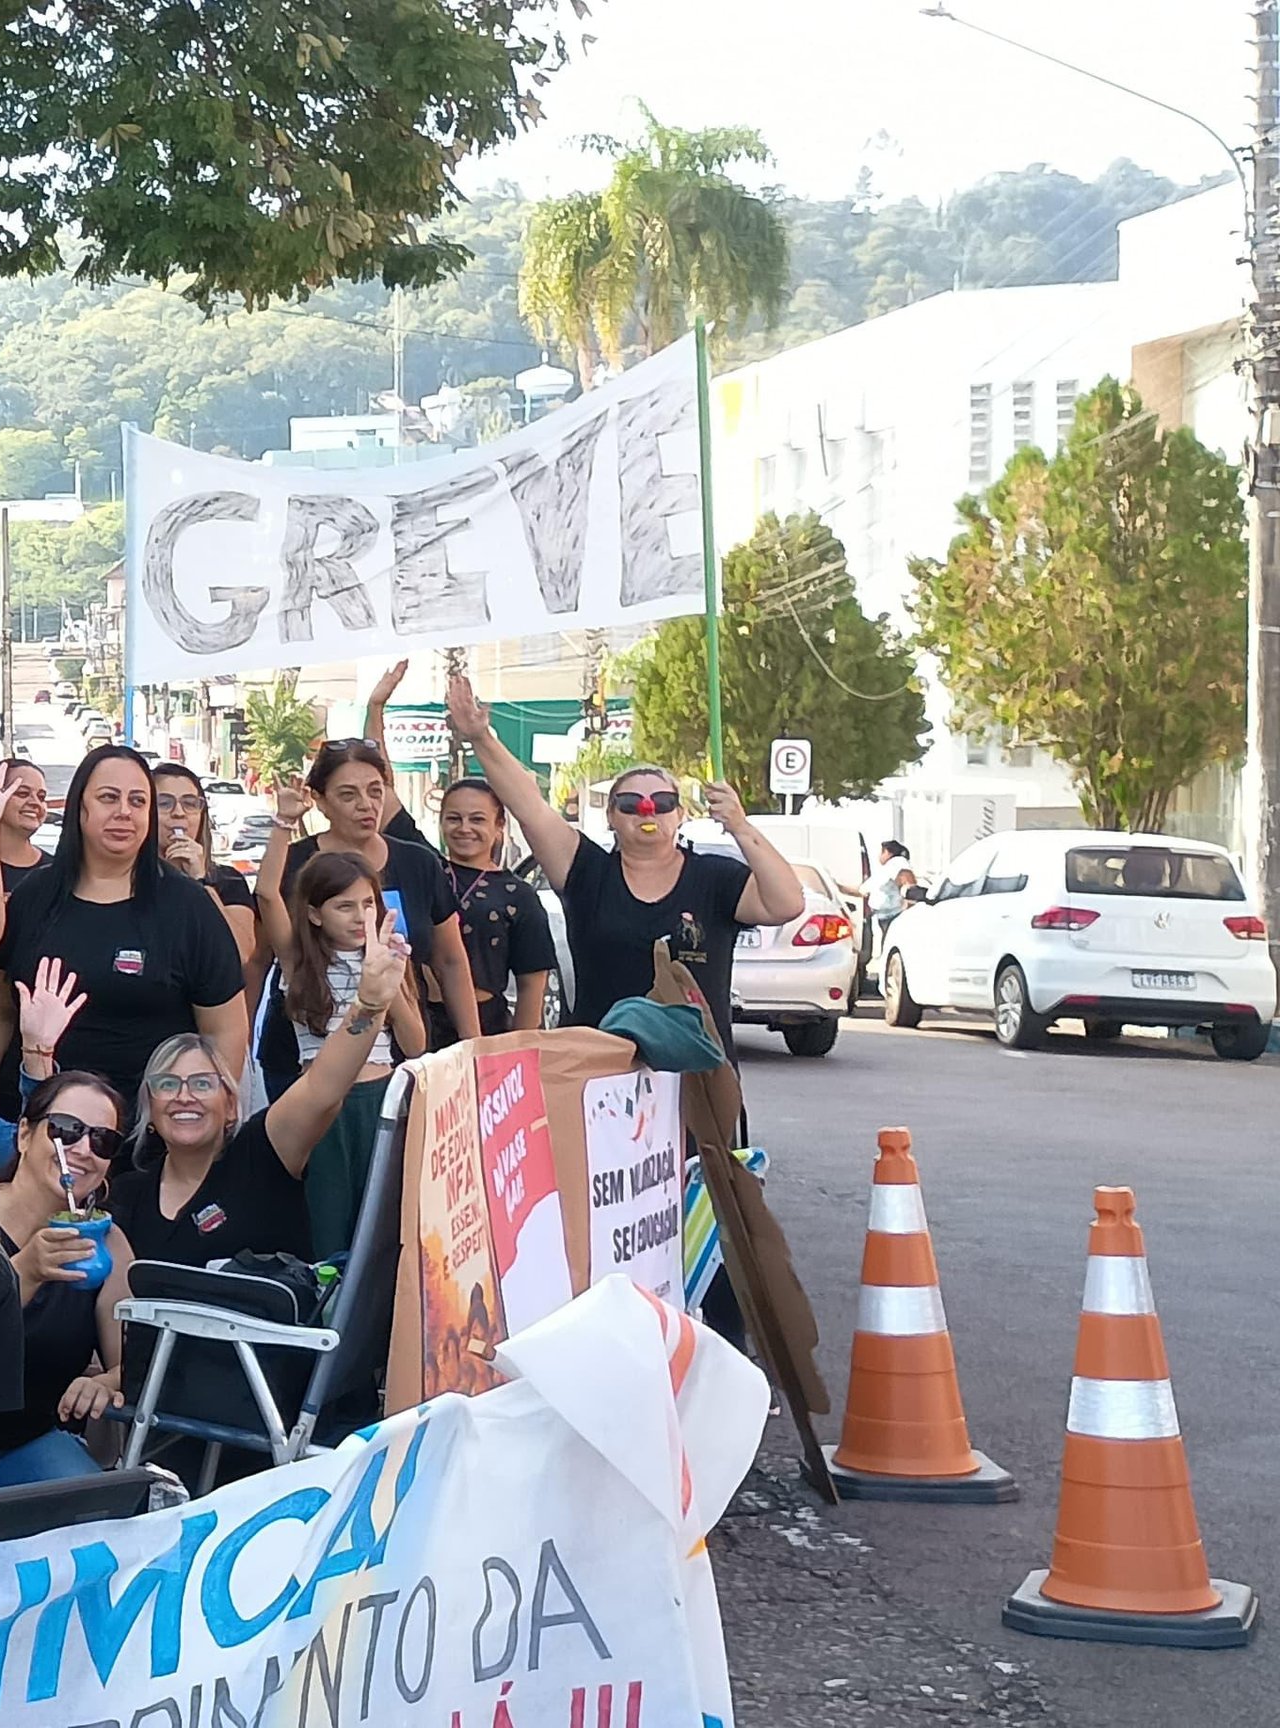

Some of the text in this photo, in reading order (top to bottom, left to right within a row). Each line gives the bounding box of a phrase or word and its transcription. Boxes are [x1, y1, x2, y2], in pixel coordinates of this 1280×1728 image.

[142, 386, 705, 655] GREVE
[785, 752, 796, 769] E
[593, 1169, 624, 1208] SEM
[613, 1222, 636, 1263] SE
[472, 1539, 612, 1683] DA
